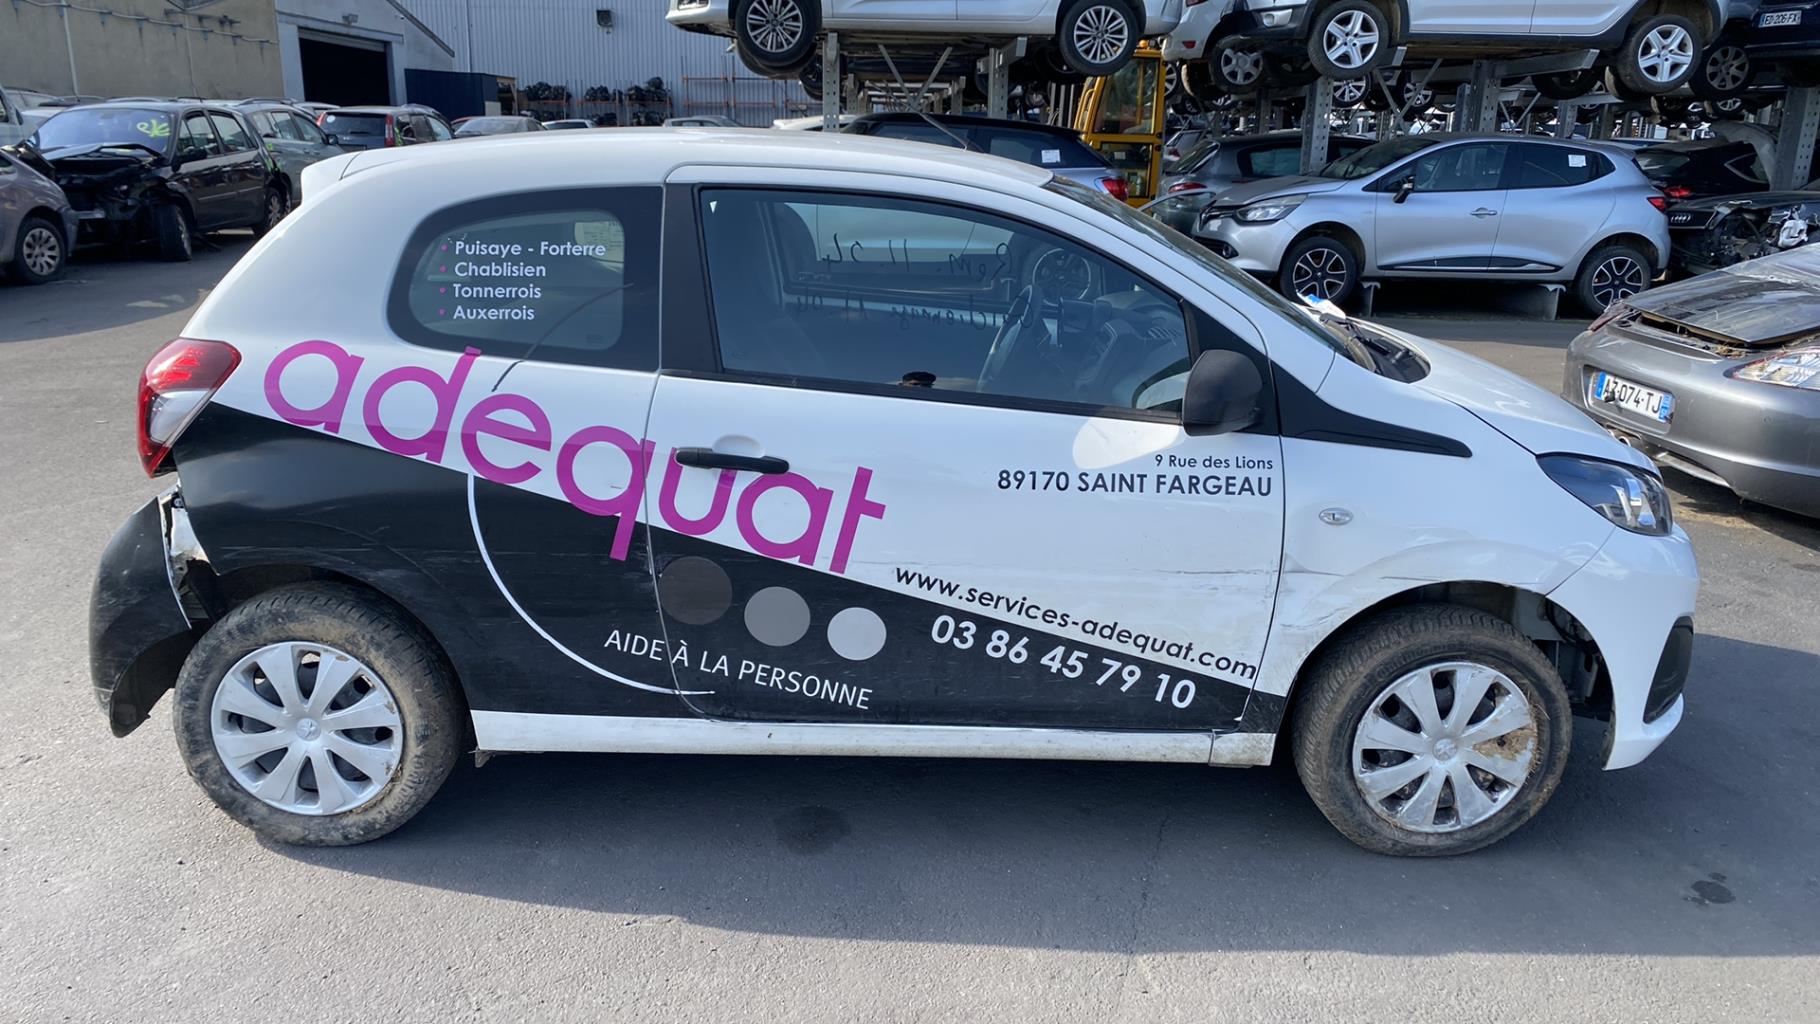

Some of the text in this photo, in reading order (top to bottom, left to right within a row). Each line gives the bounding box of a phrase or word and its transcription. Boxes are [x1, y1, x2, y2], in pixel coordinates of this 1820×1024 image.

[454, 240, 522, 258] Puisaye
[540, 241, 606, 256] Forterre
[454, 262, 546, 277] Chablisien
[453, 284, 542, 298] Tonnerrois
[453, 305, 535, 320] Auxerrois
[264, 340, 887, 575] adequat
[1154, 454, 1273, 470] 9 Rue des Lions
[997, 470, 1272, 496] 89170 SAINT FARGEAU
[896, 567, 1257, 680] www.services-adequat.com
[604, 629, 873, 709] AIDE À LA PERSONNE
[931, 614, 1196, 709] 03 86 45 79 10
